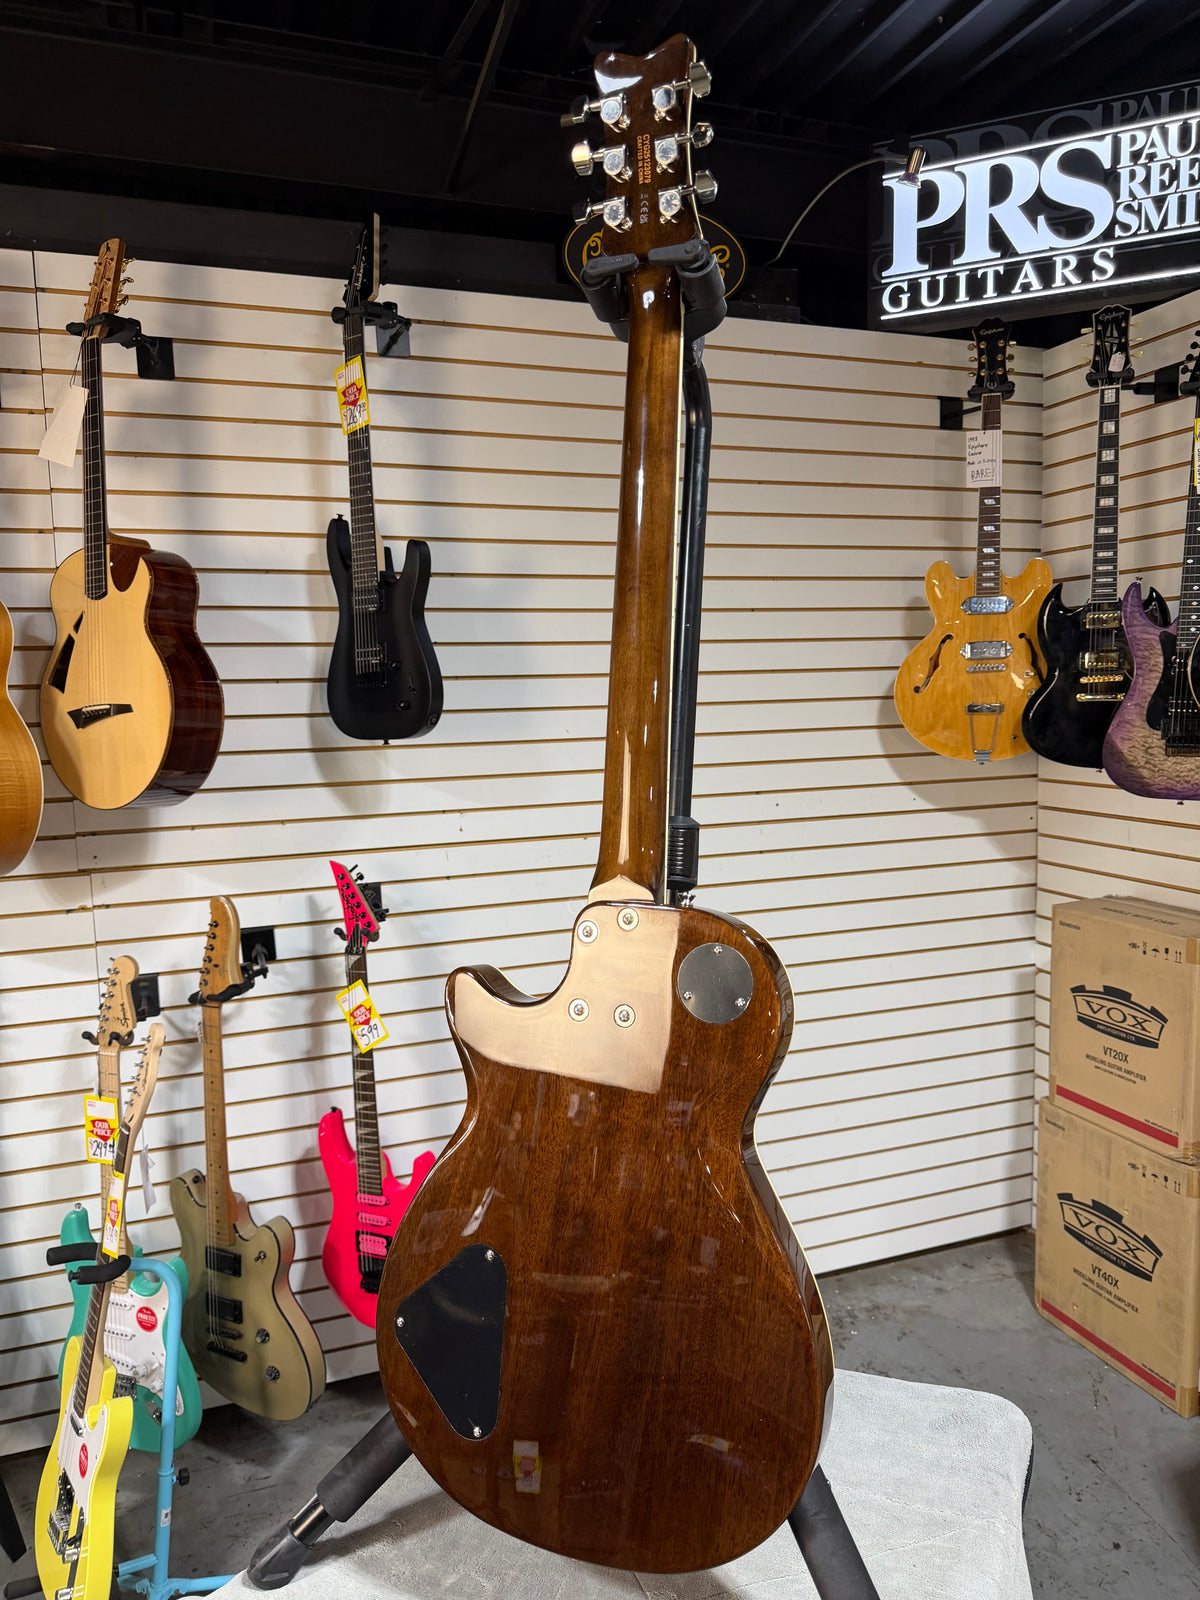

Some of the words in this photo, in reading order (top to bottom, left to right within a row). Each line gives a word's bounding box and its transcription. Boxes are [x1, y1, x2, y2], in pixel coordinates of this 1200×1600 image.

[882, 134, 1114, 278] PRS
[1115, 191, 1200, 239] SMI
[881, 247, 1115, 314] GUITARS
[1081, 998, 1152, 1034] VOX
[1103, 1045, 1129, 1064] VT20X
[1069, 1207, 1145, 1263] VOX
[1091, 1263, 1119, 1290] VT40X
